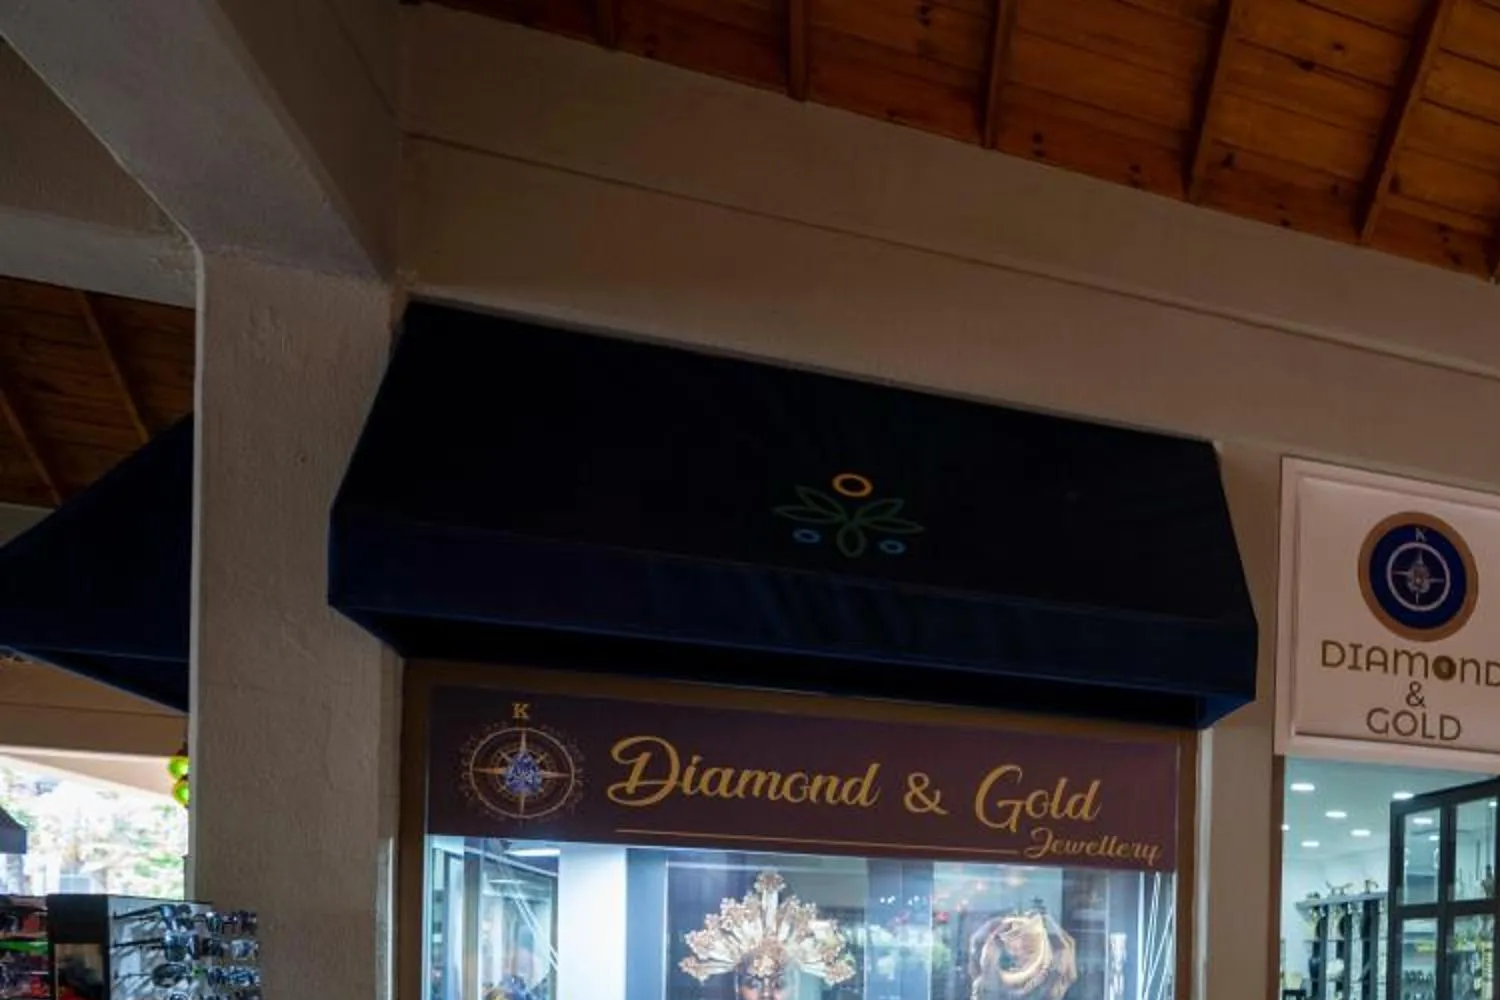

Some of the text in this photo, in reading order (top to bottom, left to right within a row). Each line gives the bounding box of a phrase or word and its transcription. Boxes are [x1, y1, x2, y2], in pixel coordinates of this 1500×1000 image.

[511, 702, 531, 720] K
[1404, 680, 1426, 708] &
[1365, 706, 1462, 742] GOLD
[606, 734, 1102, 834] Diamond & Gold
[1023, 825, 1162, 867] Jewellery
